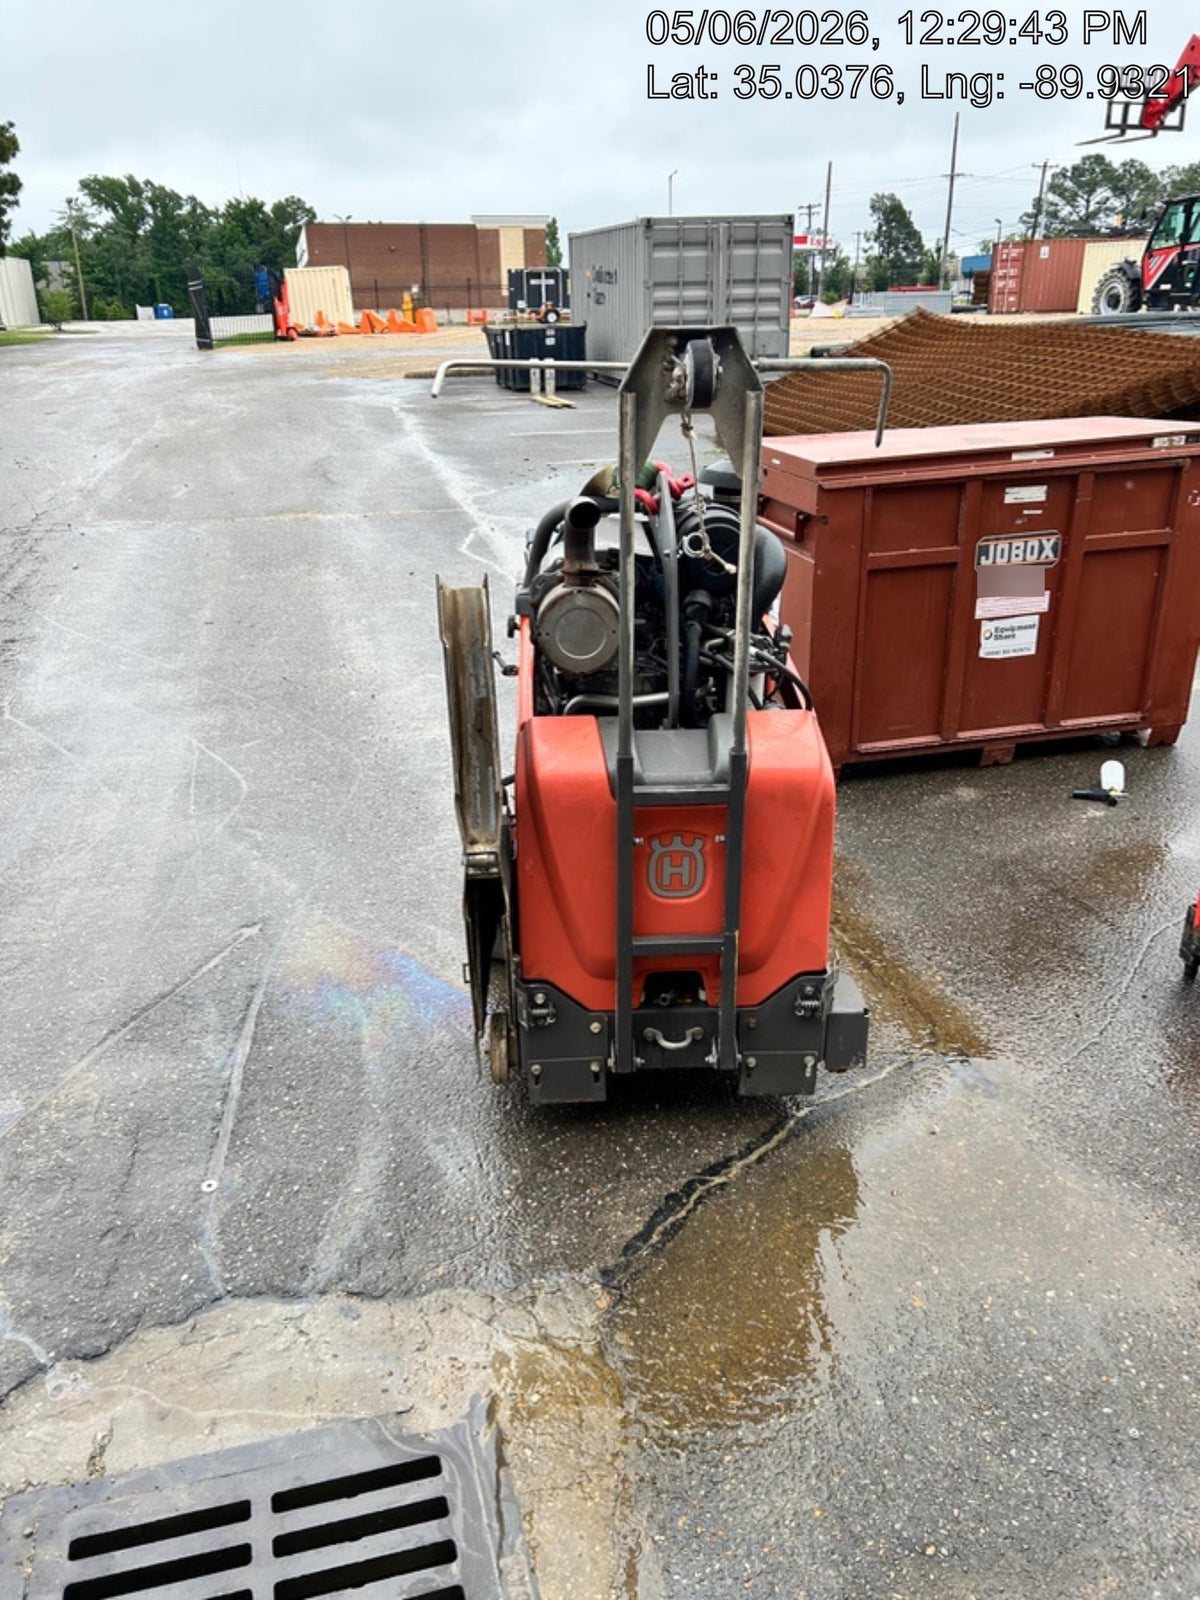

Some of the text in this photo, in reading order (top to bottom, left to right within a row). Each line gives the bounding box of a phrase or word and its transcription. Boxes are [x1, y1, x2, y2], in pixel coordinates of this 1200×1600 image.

[810, 236, 833, 247] Exxn
[981, 537, 1057, 565] JOBOX
[662, 855, 690, 886] H
